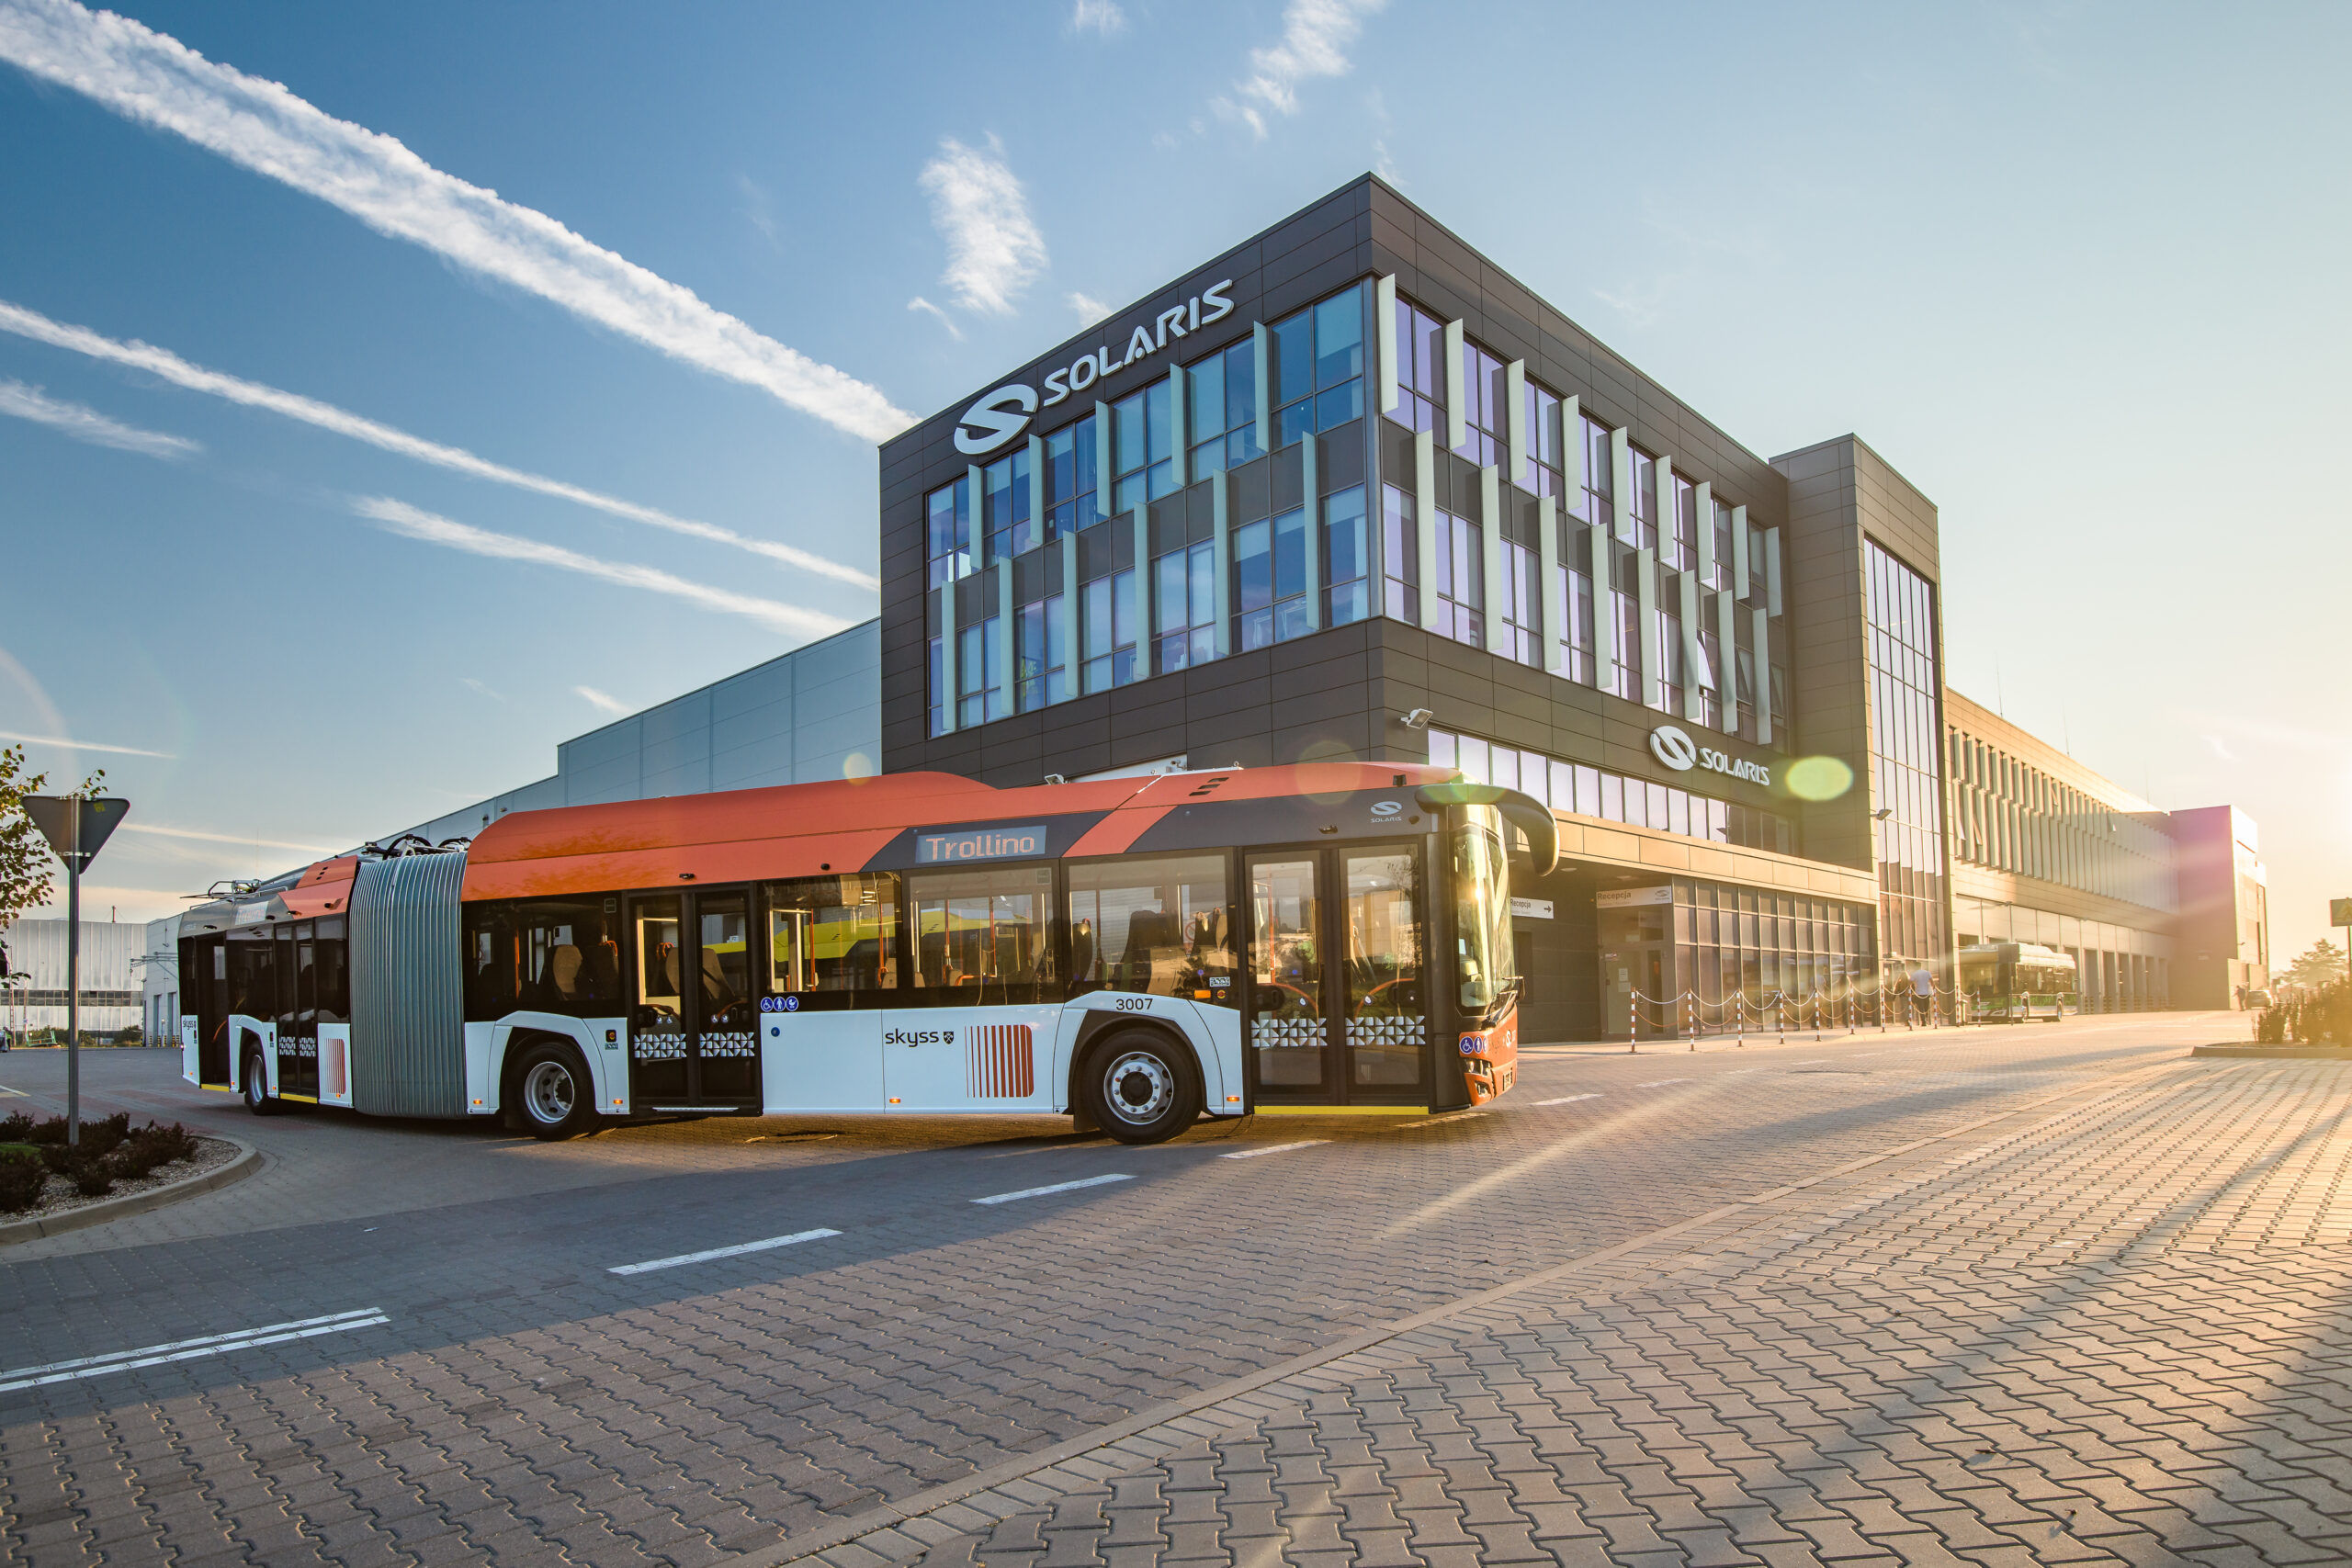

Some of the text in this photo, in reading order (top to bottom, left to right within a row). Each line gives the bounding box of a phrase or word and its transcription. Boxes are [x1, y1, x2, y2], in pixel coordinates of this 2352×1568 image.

[1044, 278, 1235, 407] SOLARIS
[1700, 747, 1770, 786] SOLARIS
[1370, 816, 1402, 824] SOLARIS
[925, 833, 1035, 861] Trollino
[1597, 890, 1632, 900] Recepcja
[1115, 998, 1153, 1010] 3007
[885, 1028, 939, 1047] skyss
